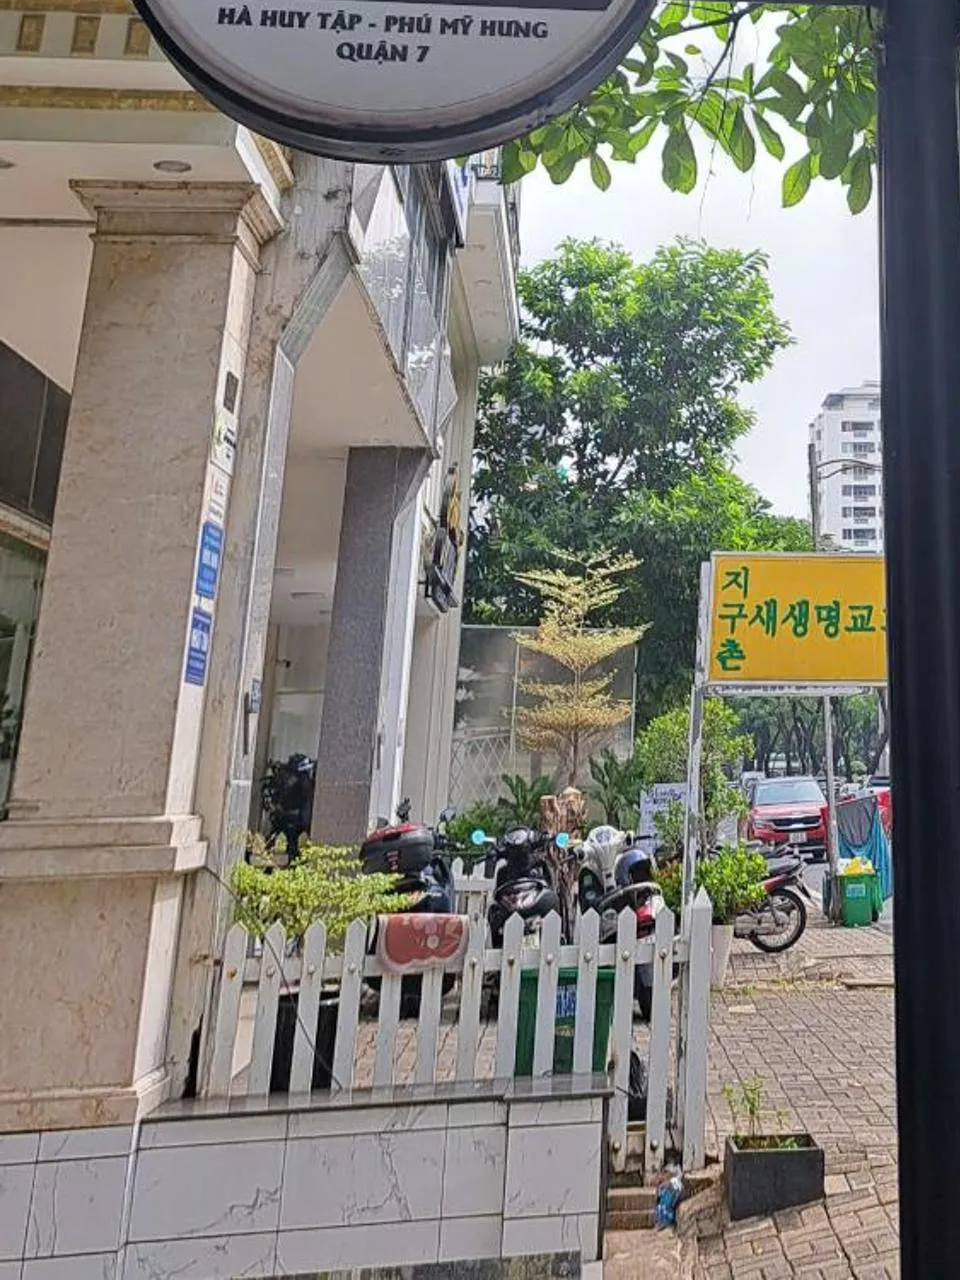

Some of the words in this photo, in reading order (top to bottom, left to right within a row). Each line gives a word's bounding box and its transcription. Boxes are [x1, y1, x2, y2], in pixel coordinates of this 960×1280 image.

[217, 4, 252, 27] HÀ
[259, 9, 311, 29] HUY
[317, 9, 363, 35] TẬP
[383, 13, 433, 34] PHÚ
[439, 14, 474, 36] MỸ
[335, 40, 409, 66] QUẬN
[416, 45, 431, 63] 7
[748, 598, 887, 638] 새생명교
